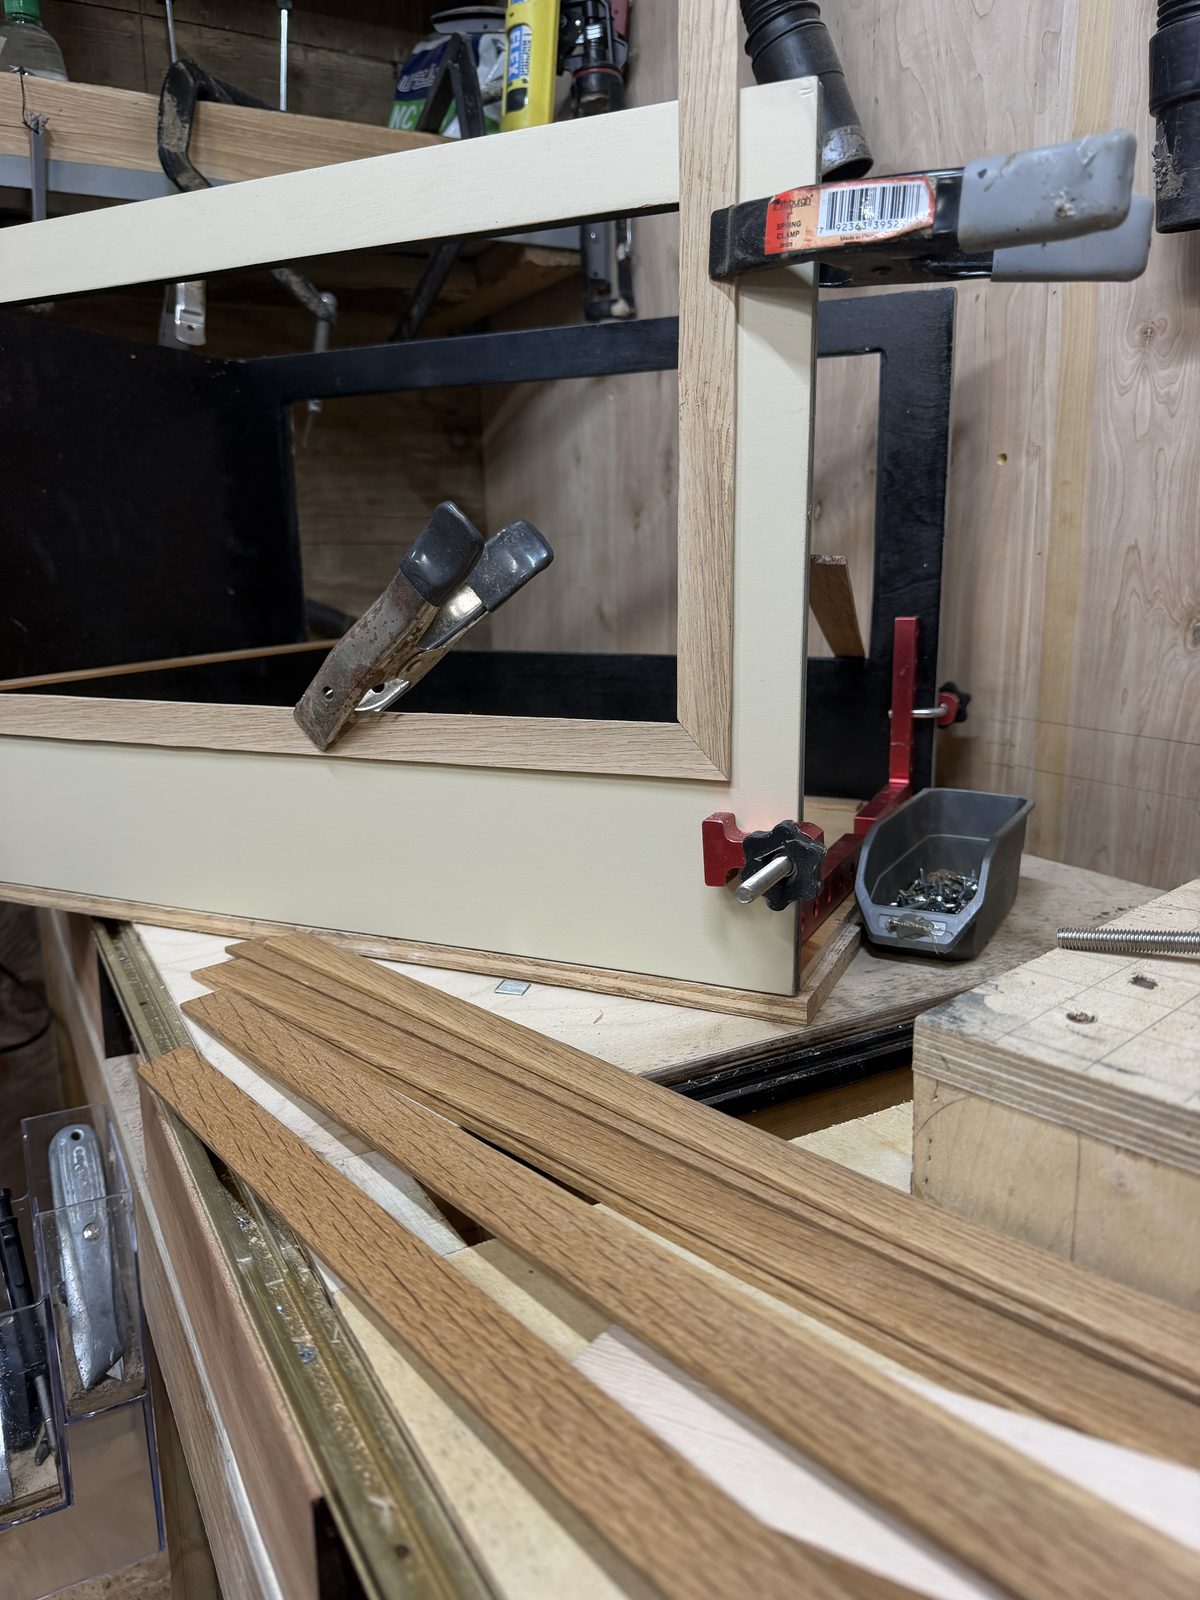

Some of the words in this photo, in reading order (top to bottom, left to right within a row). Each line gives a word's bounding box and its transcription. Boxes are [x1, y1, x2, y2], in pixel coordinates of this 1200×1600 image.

[819, 226, 824, 234] 7
[835, 221, 867, 232] 92363
[776, 230, 800, 240] CLAMP
